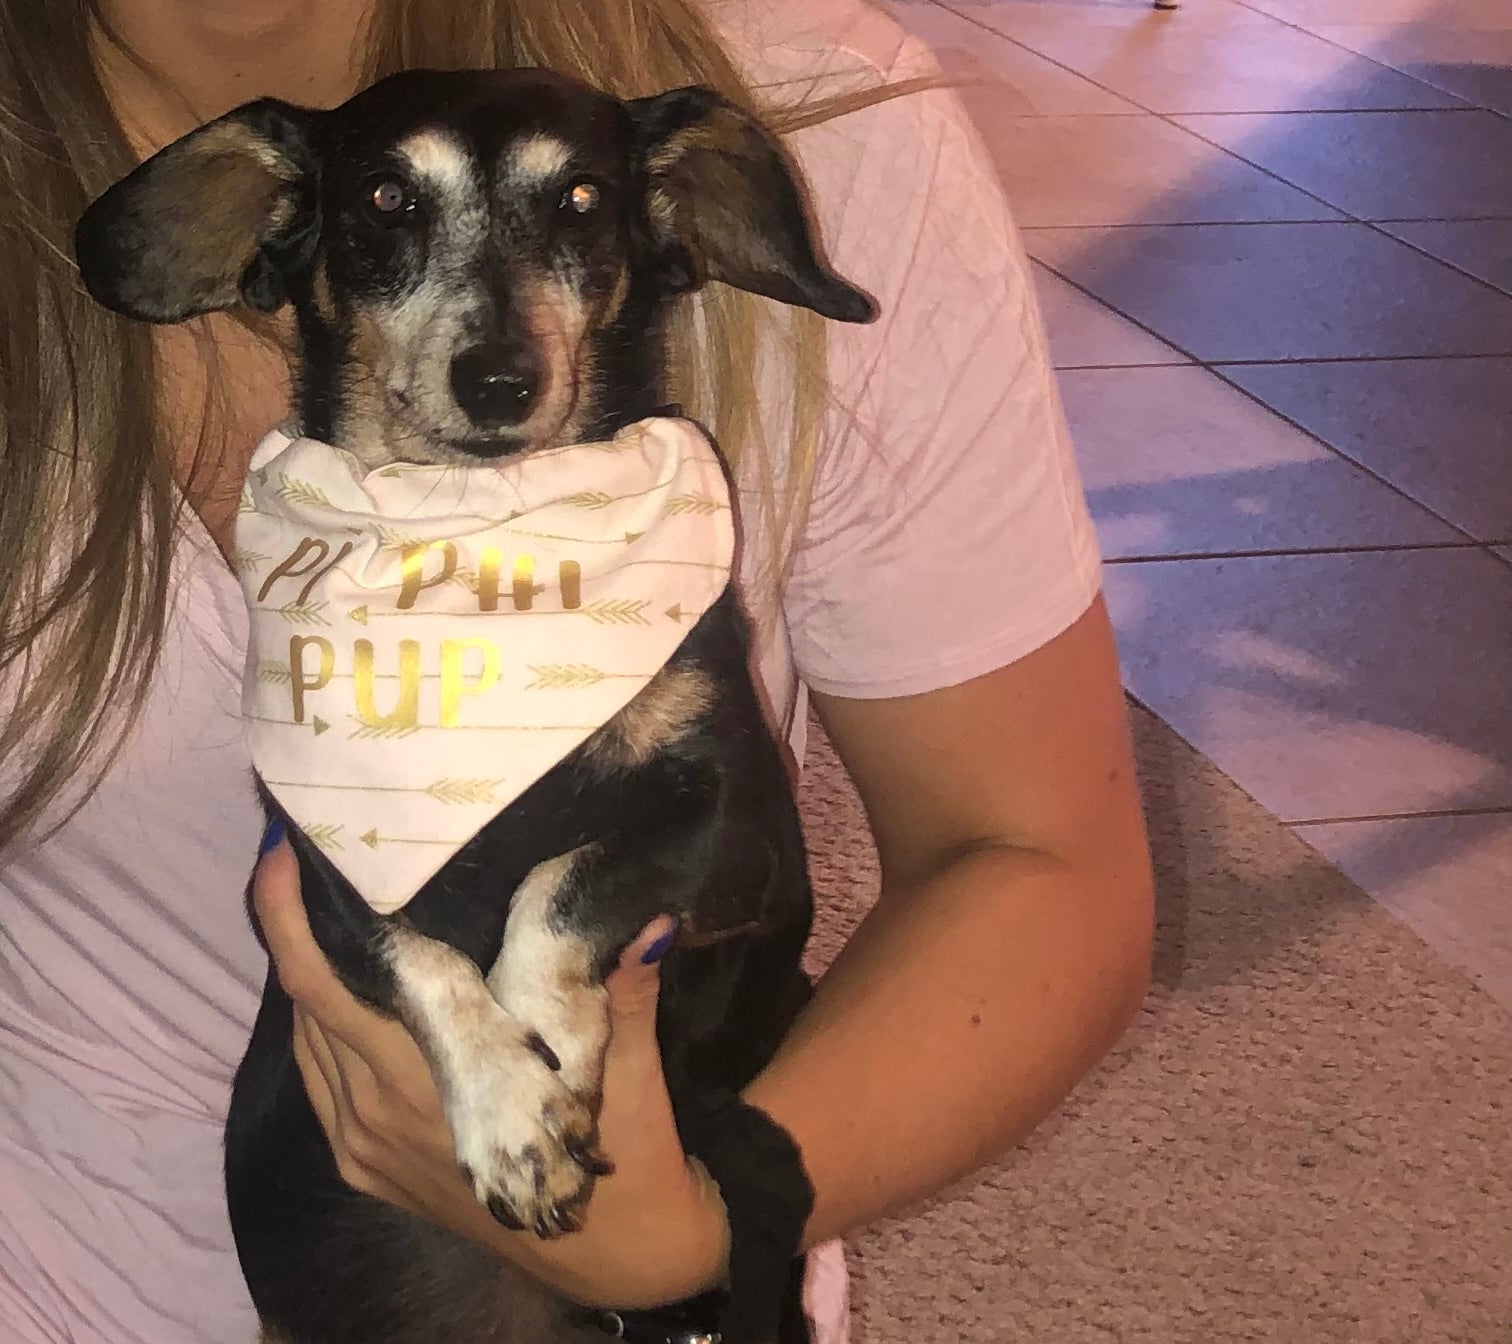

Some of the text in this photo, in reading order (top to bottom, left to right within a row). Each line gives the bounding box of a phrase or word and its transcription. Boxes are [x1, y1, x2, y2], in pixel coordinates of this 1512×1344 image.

[257, 537, 581, 611] PI PHI
[290, 634, 502, 729] PUP
